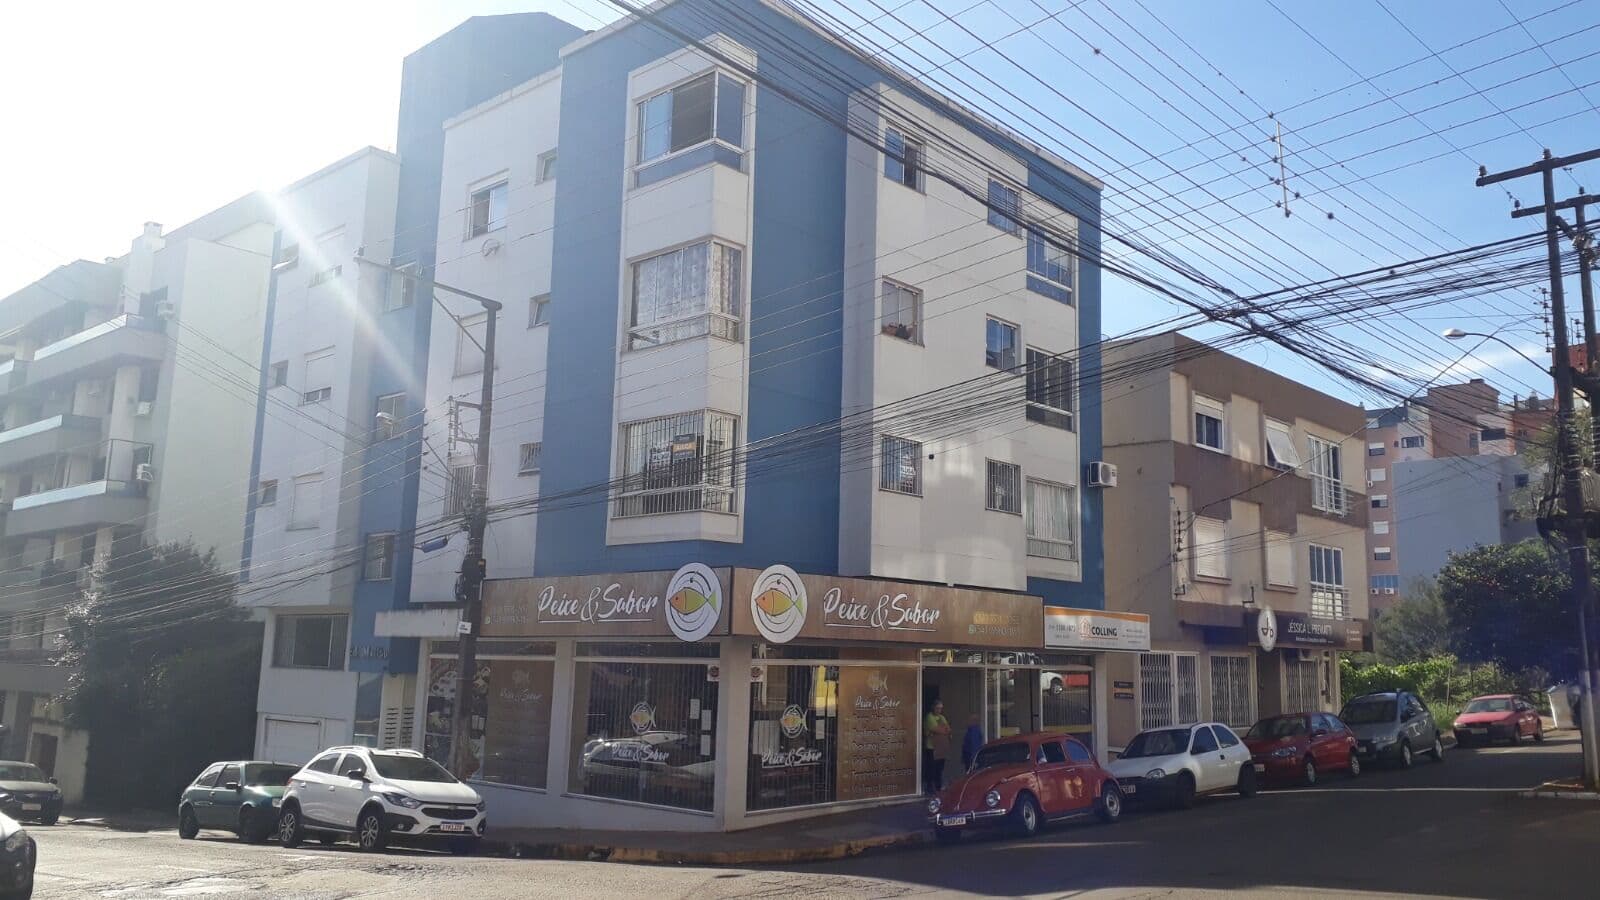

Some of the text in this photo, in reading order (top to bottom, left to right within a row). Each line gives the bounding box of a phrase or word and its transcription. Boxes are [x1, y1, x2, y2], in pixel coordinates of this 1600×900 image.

[537, 583, 659, 624] Peixe & Sabor
[823, 587, 940, 631] Peixe & Sabor
[1091, 626, 1118, 637] COLLING
[640, 744, 670, 761] Sabor
[793, 746, 822, 764] Sabor
